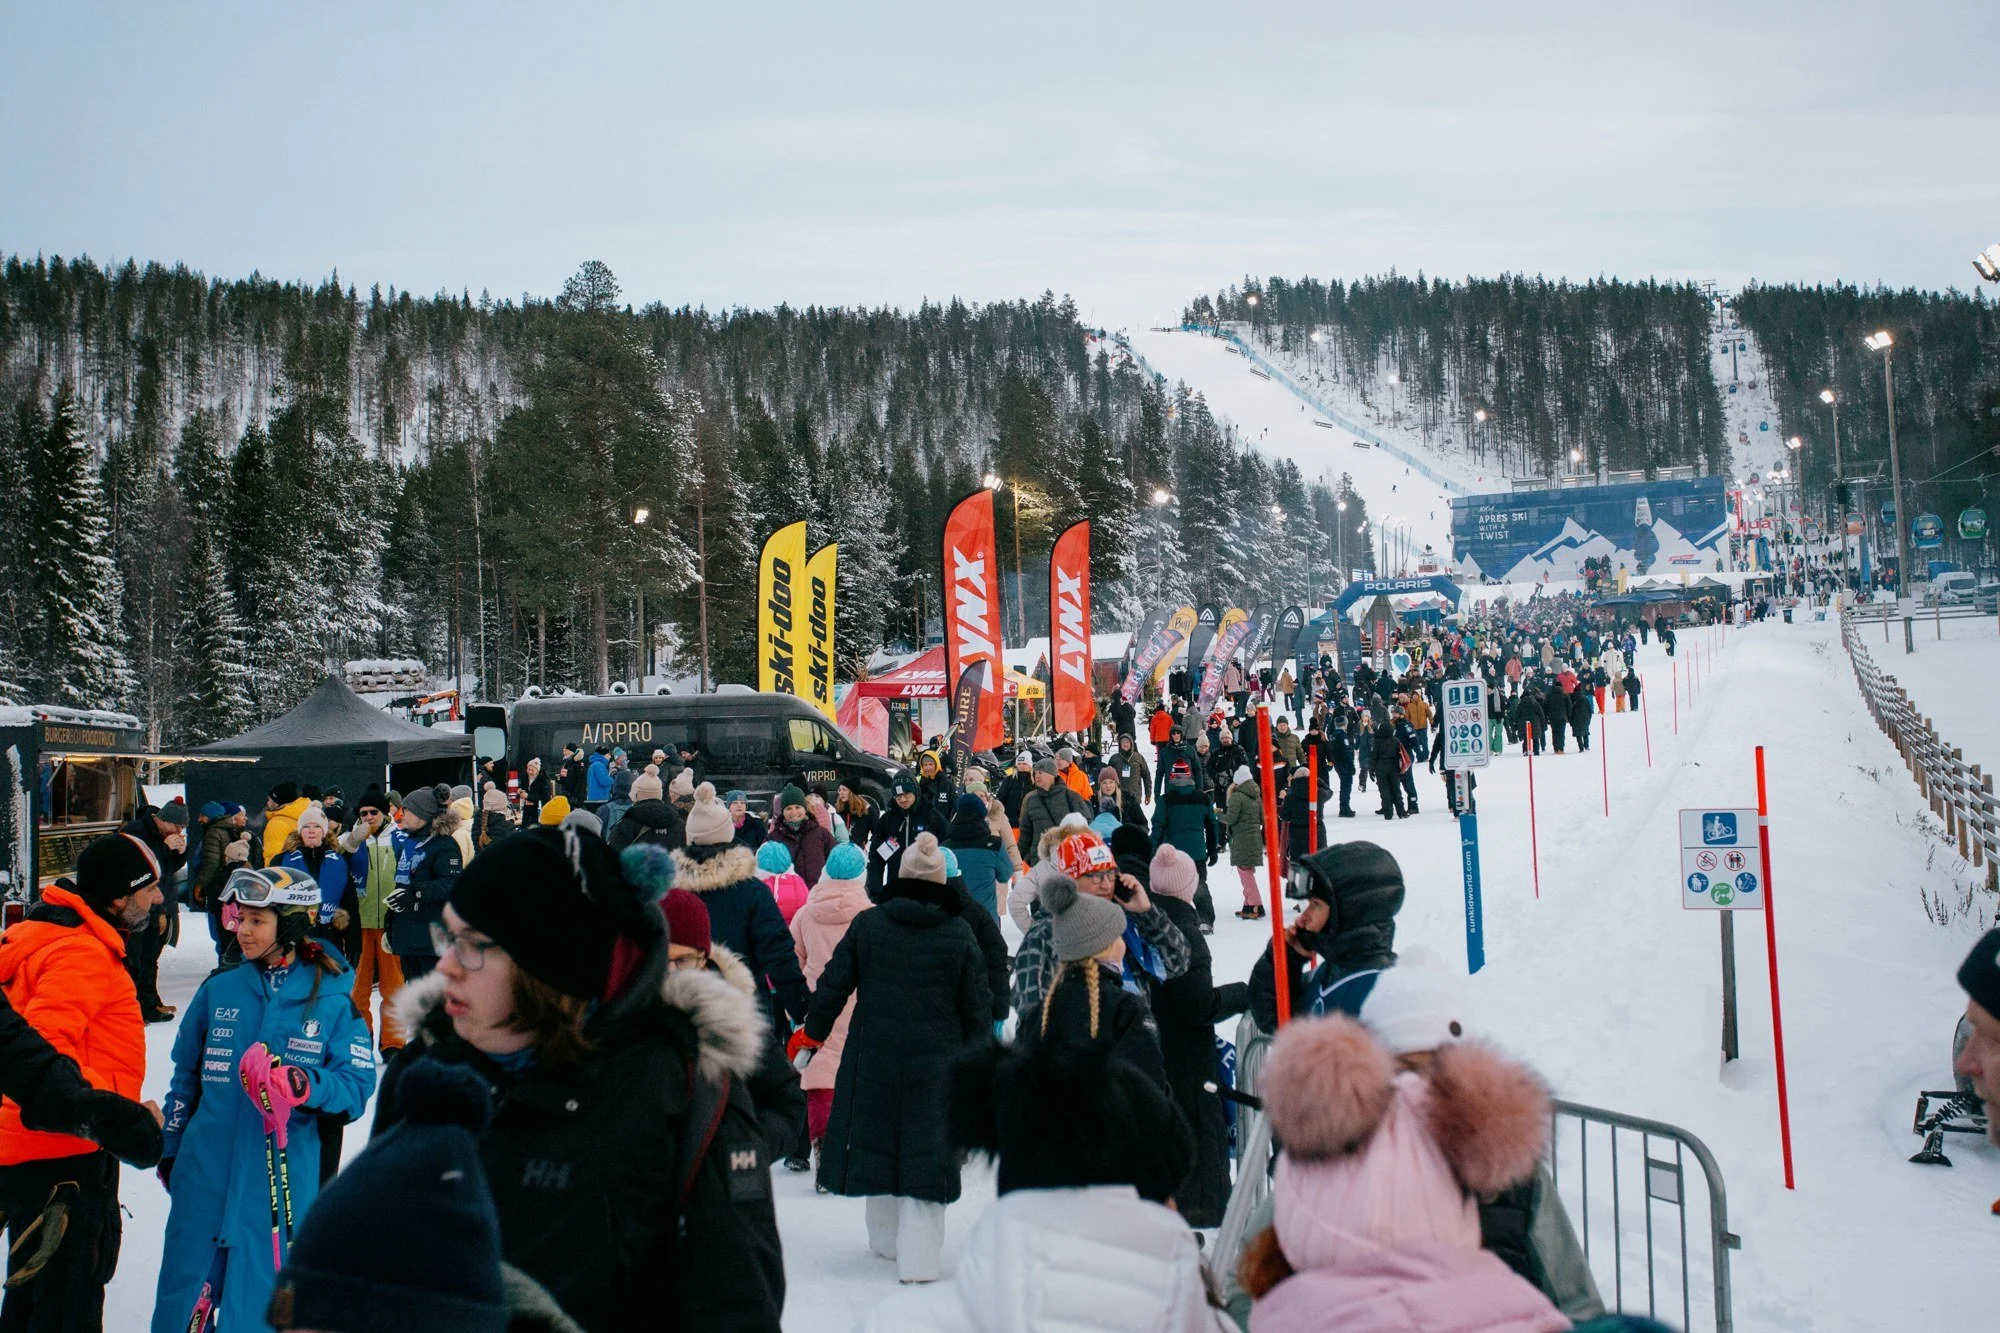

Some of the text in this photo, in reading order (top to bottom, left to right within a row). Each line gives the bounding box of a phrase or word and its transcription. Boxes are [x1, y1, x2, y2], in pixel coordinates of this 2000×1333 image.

[1511, 511, 1528, 521] SKI
[1479, 530, 1509, 541] TWIST
[1363, 579, 1432, 592] POLARIS
[1056, 565, 1088, 685] LYNX
[808, 575, 829, 704] ski-doo
[1246, 619, 1270, 660] Bridgedale
[900, 684, 942, 696] LYNX
[1464, 850, 1476, 934] sunkidworld.com
[214, 1007, 240, 1018] EA7
[730, 1150, 757, 1172] HH
